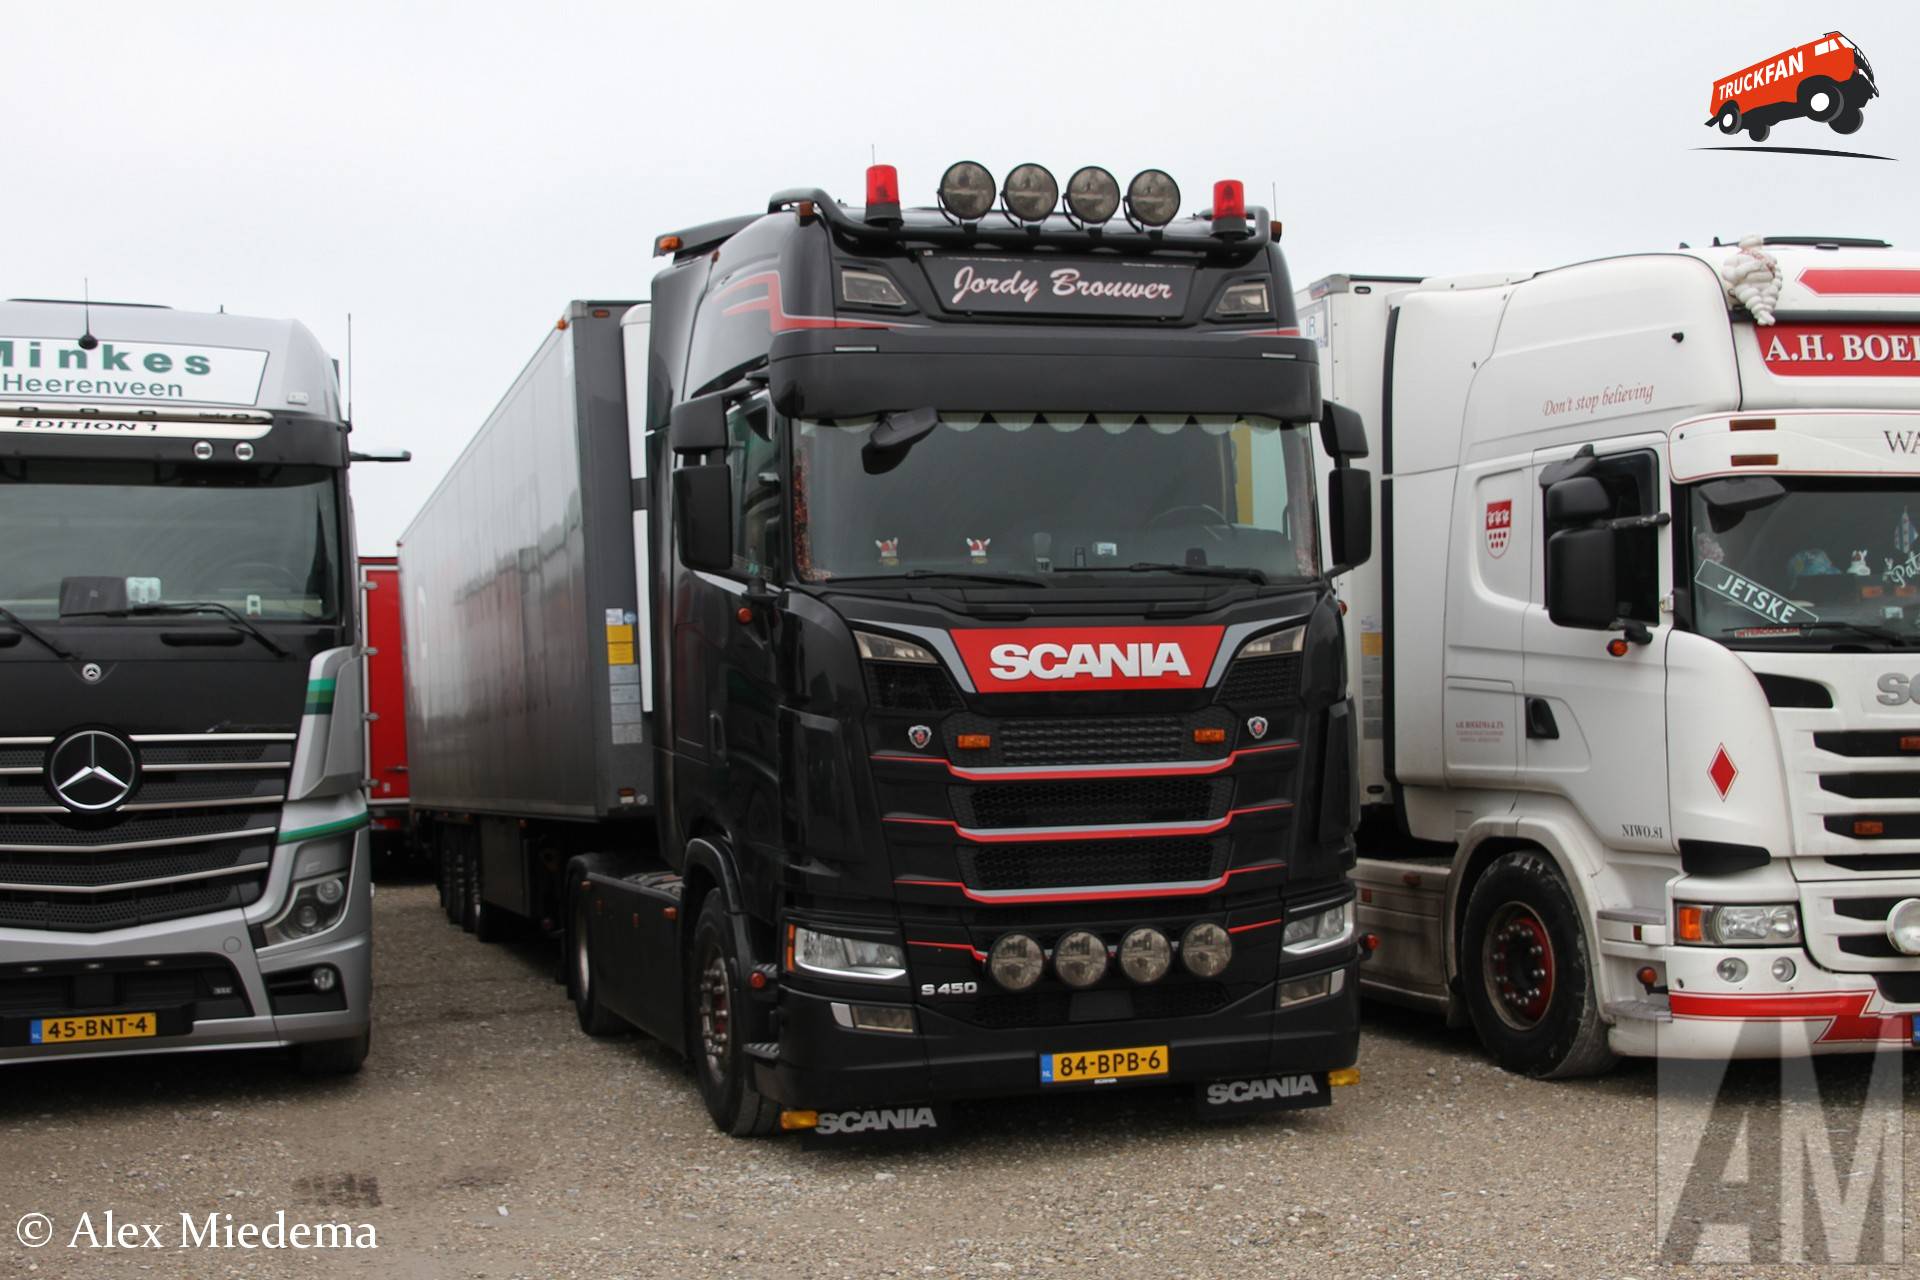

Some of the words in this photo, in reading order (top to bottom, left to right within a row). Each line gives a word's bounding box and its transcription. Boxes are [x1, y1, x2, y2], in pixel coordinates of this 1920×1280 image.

[951, 266, 1038, 304] Jordy
[1050, 268, 1173, 299] Brouwer
[1765, 334, 1834, 361] A.H.
[3, 373, 183, 397] Heerenveen
[1542, 397, 1573, 416] Don't
[1576, 395, 1600, 414] stop
[1602, 382, 1654, 405] believing
[16, 420, 136, 431] EDITION
[1717, 574, 1796, 624] JETSKE
[989, 642, 1192, 680] SCANIA
[921, 984, 935, 996] S
[938, 982, 978, 995] 450
[49, 1016, 148, 1039] 45-BNT-4
[1060, 1049, 1161, 1076] 84-BPB-6
[1207, 1074, 1318, 1105] SCANIA
[815, 1107, 938, 1135] SCANIA
